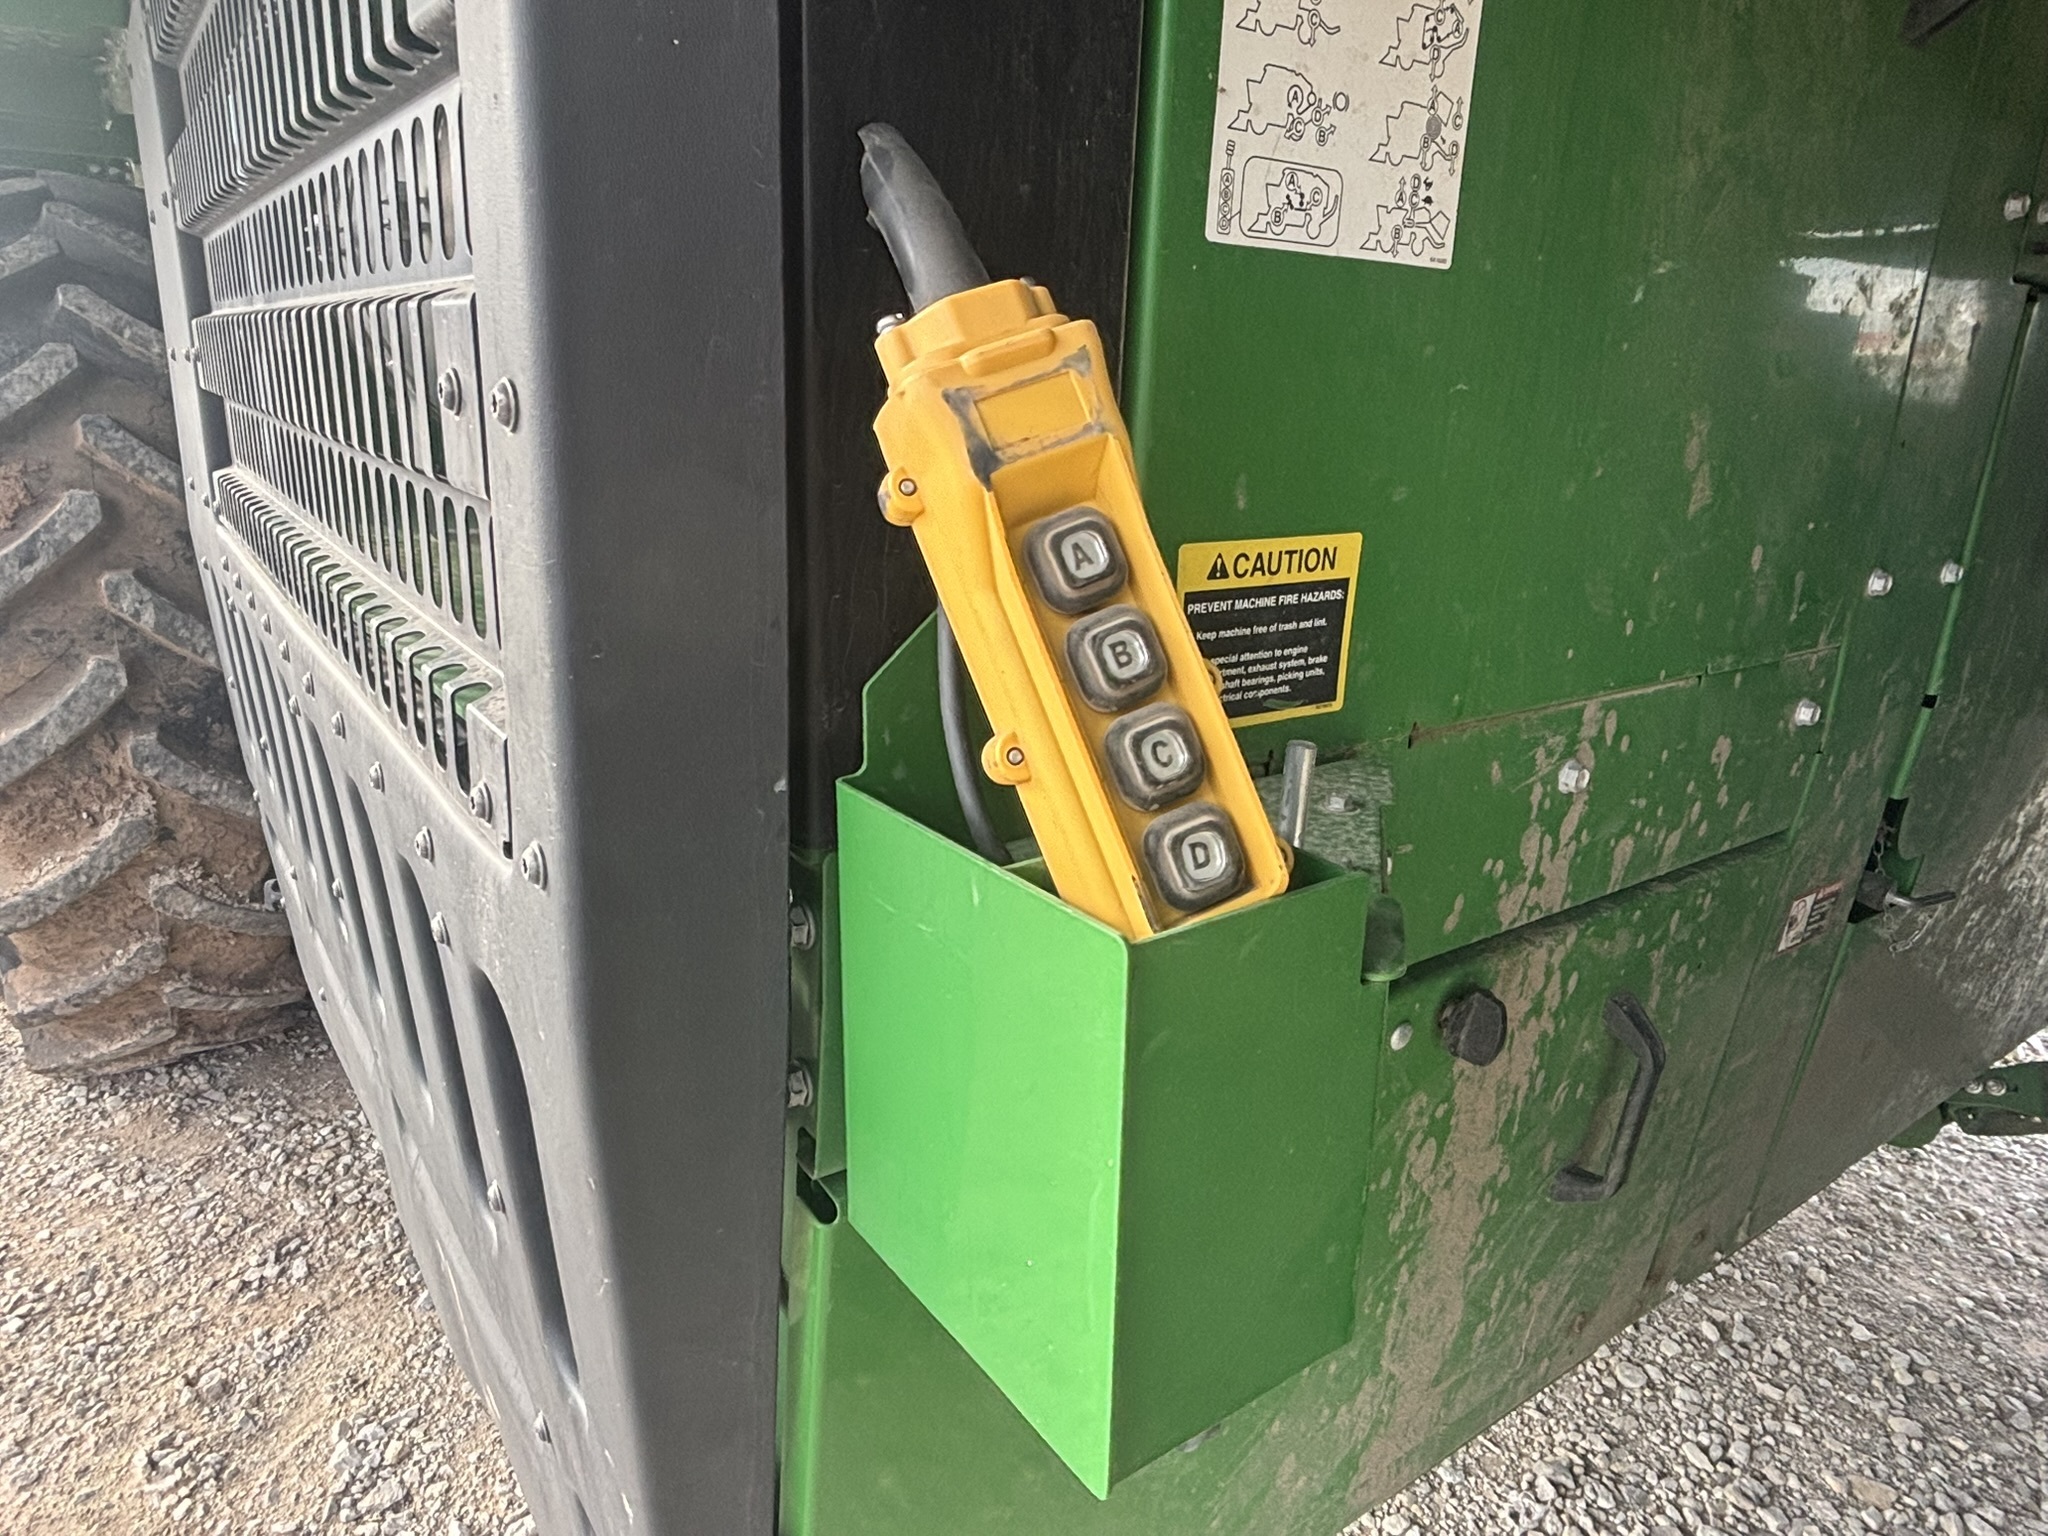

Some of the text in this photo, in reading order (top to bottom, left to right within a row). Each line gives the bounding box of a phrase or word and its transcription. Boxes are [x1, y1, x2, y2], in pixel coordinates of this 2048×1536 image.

[1310, 13, 1318, 26] C
[1436, 8, 1444, 22] C
[1454, 22, 1461, 34] A
[1432, 48, 1440, 60] D
[1291, 90, 1299, 103] A
[1429, 100, 1436, 111] A
[1314, 110, 1322, 122] D
[1454, 114, 1461, 128] C
[1295, 120, 1302, 134] C
[1319, 130, 1326, 142] B
[1423, 136, 1430, 148] B
[1452, 144, 1458, 156] D
[1287, 174, 1296, 186] A
[1414, 177, 1420, 189] D
[1312, 190, 1320, 203] C
[1397, 192, 1404, 204] A
[1410, 192, 1418, 206] C
[1274, 210, 1282, 223] B
[1394, 228, 1400, 240] B
[1071, 542, 1092, 571] A
[1233, 546, 1338, 578] CAUTION
[1187, 589, 1345, 615] PREVENT MACHINE FIRE HAZARDS:
[1196, 617, 1328, 641] Keep machine free of trash and lint.
[1108, 640, 1132, 670] B
[1210, 645, 1308, 666] special attention to engine
[1220, 654, 1328, 678] tment, exhaust system, brake
[1242, 674, 1276, 688] bearings,
[1276, 670, 1304, 684] picking
[1305, 667, 1325, 678] units,
[1220, 690, 1242, 702] trical
[1150, 739, 1172, 768] C
[1188, 841, 1212, 870] D
